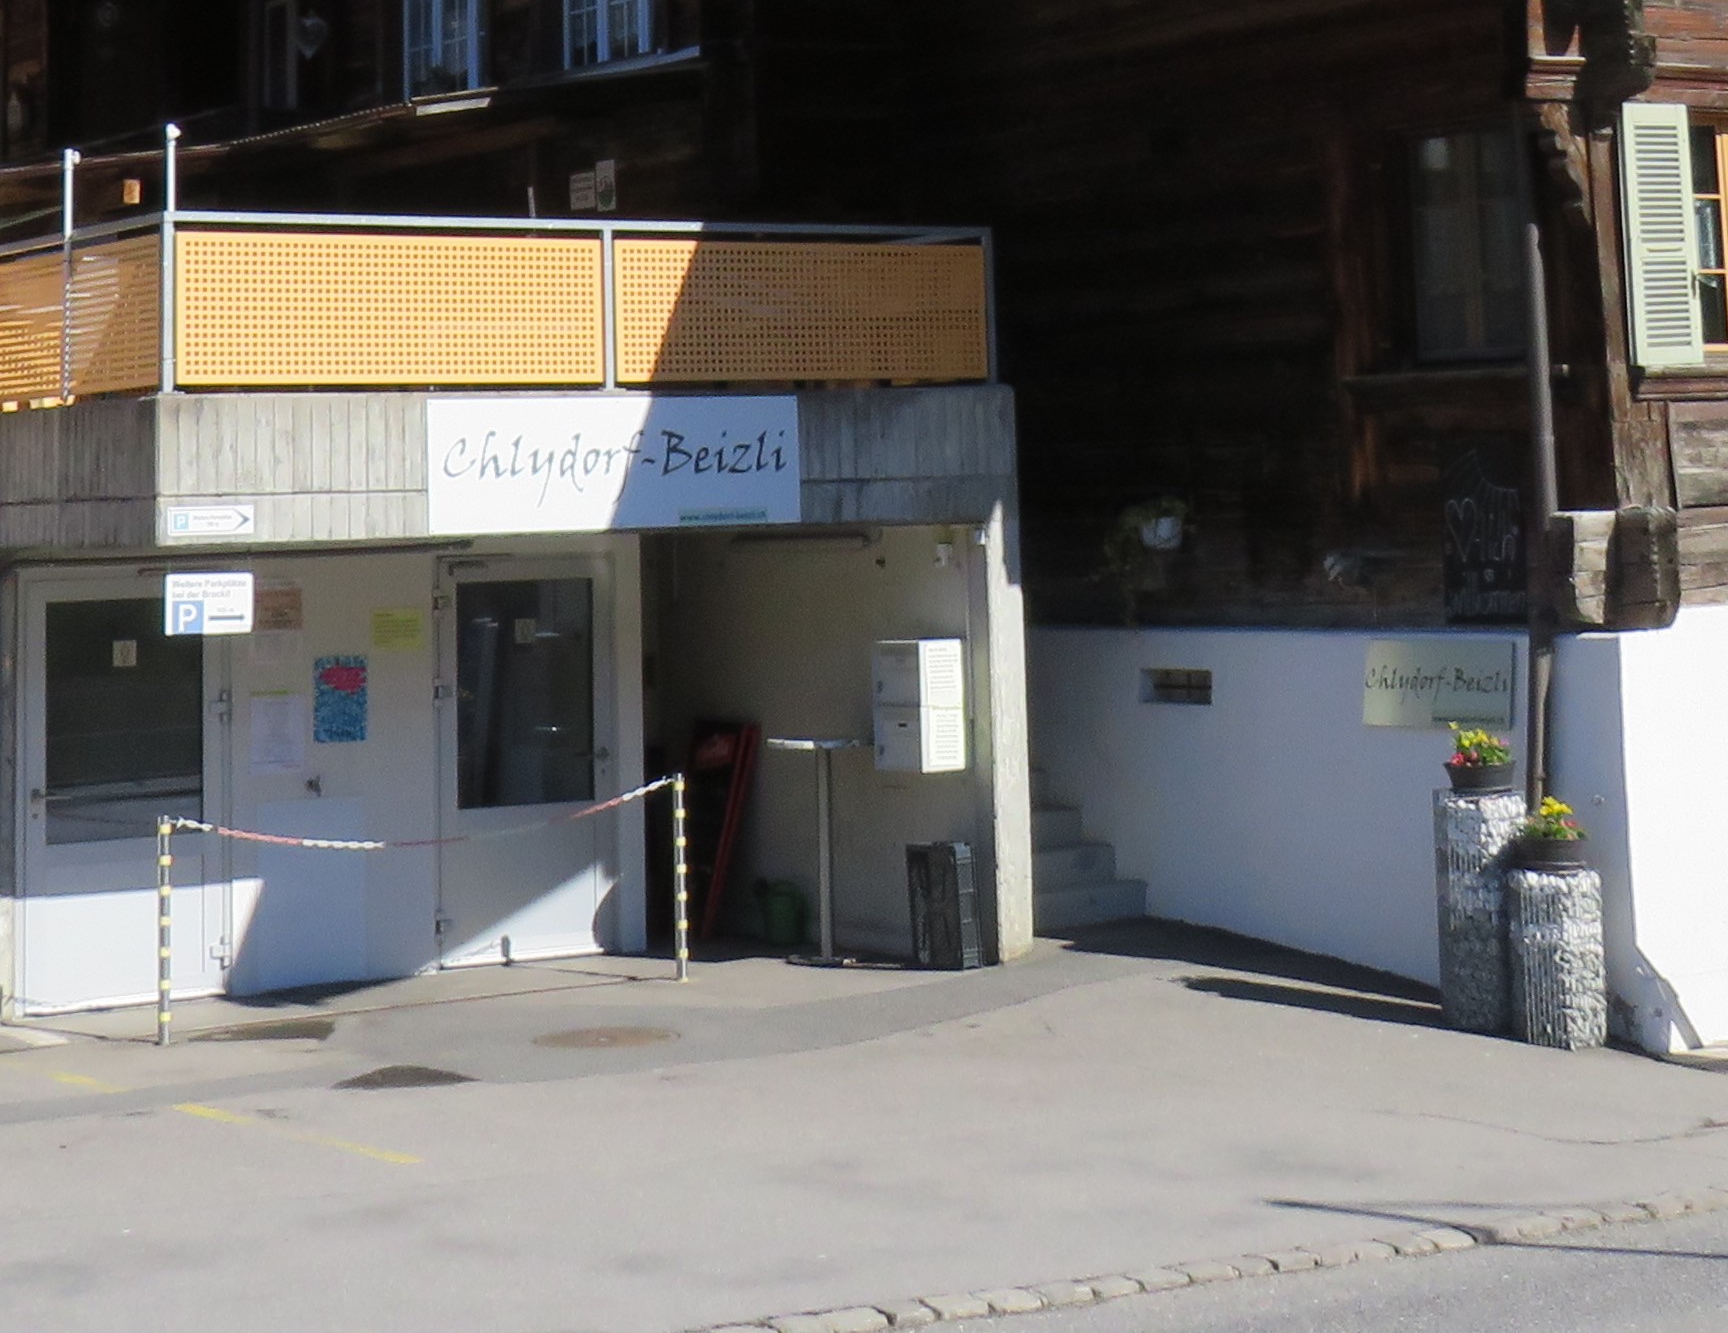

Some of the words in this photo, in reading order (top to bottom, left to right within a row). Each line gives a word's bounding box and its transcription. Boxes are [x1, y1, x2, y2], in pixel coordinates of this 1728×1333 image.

[443, 430, 787, 509] Chlydorf-Beizli
[178, 604, 197, 633] P
[1364, 665, 1509, 706] Chlydorf-Beizli
